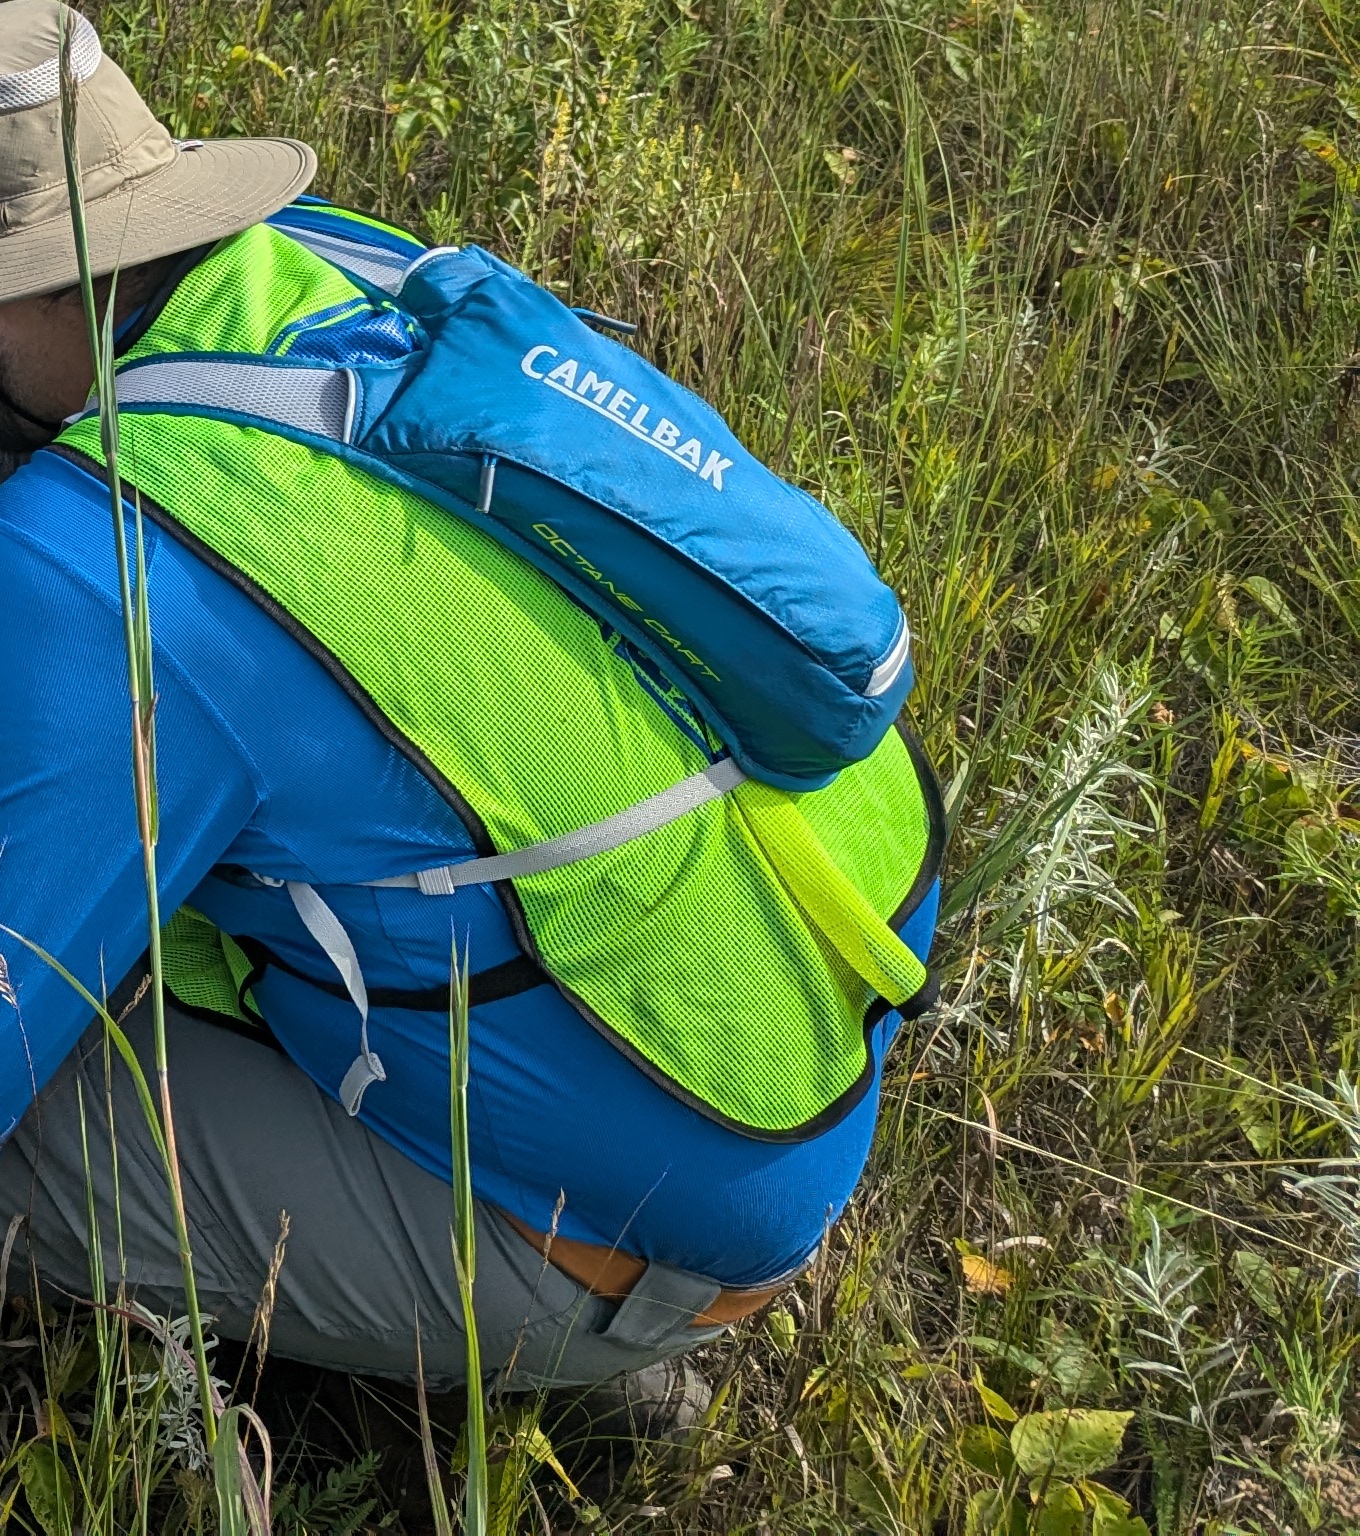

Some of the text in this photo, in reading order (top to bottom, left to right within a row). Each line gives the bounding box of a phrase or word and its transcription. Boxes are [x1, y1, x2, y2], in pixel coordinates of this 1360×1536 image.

[520, 345, 734, 492] CAMELBAK
[532, 523, 722, 682] OCTANE DART
